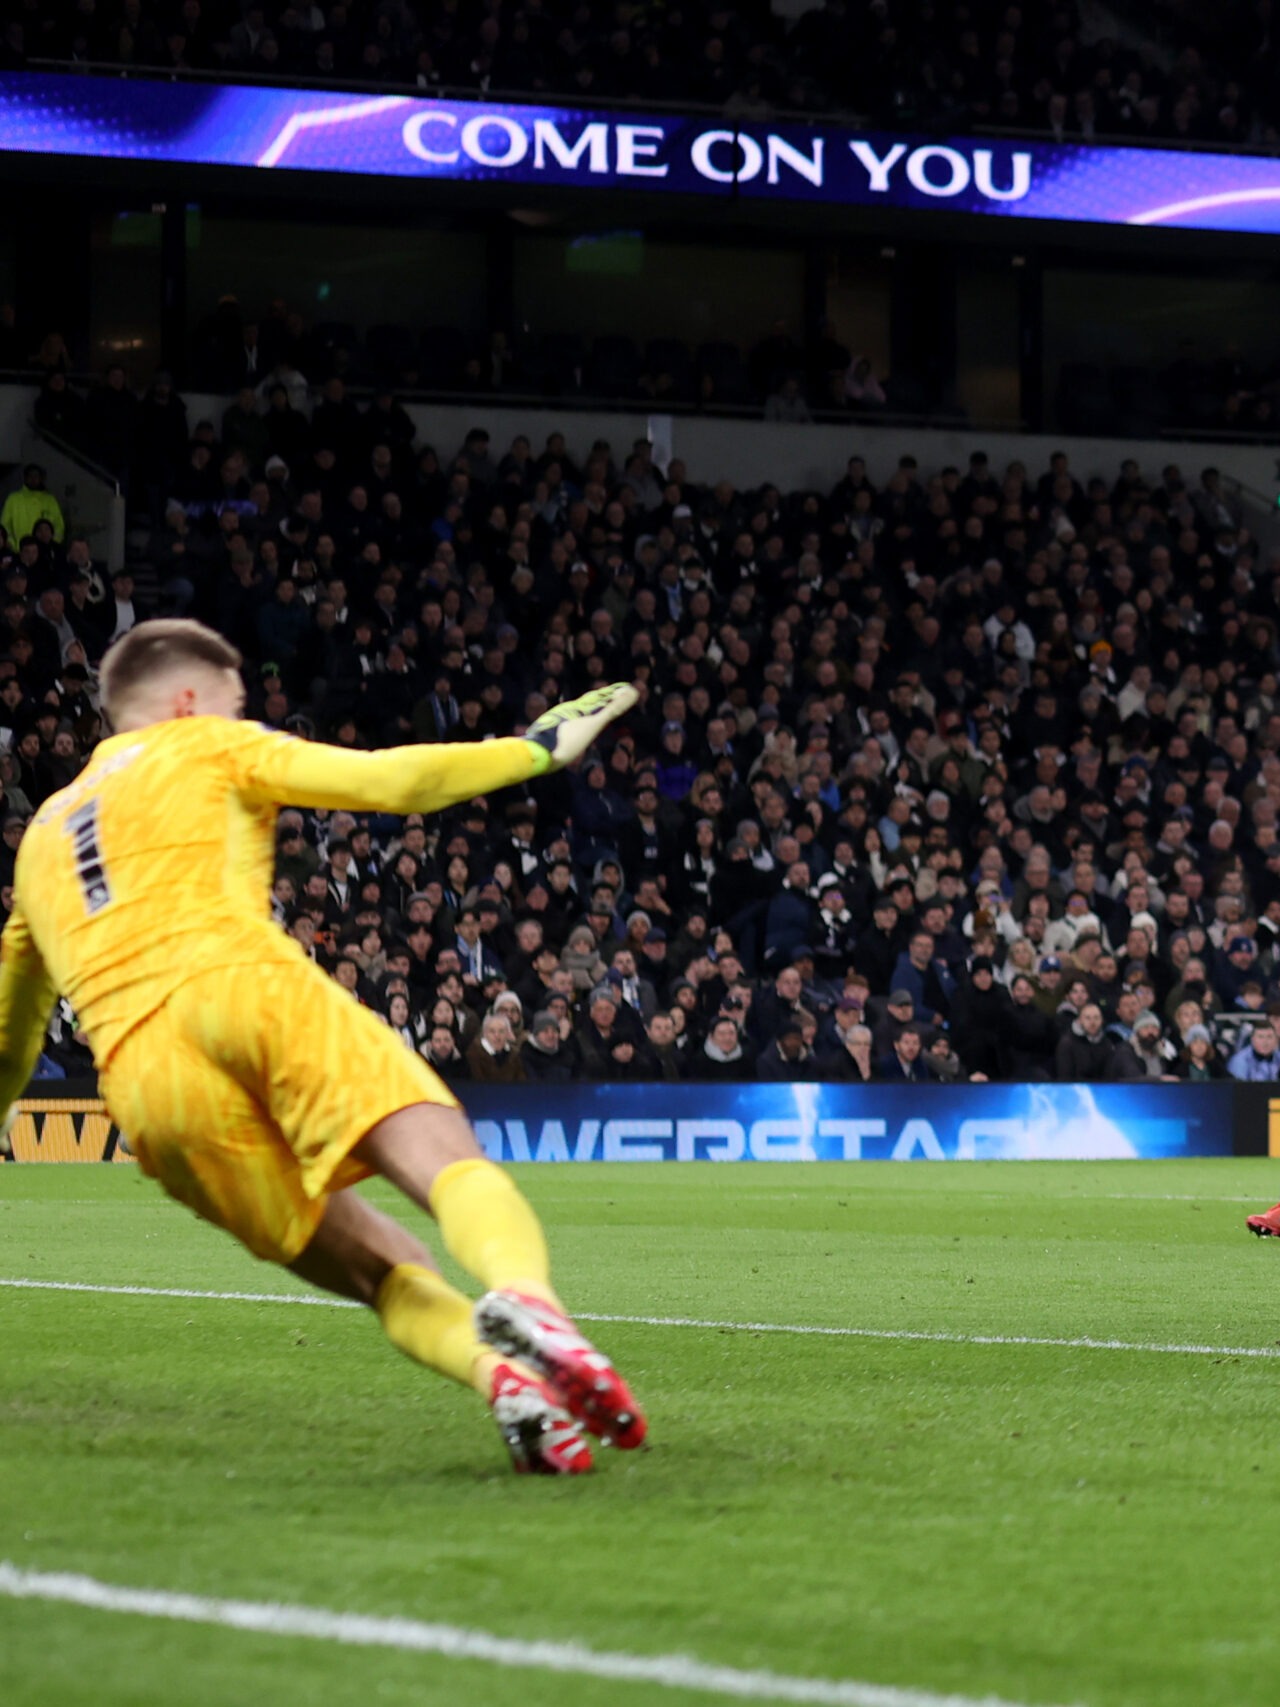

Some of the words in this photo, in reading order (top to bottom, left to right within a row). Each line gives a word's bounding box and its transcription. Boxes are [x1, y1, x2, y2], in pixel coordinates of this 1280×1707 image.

[402, 110, 669, 177] COME
[690, 129, 824, 188] ON
[849, 140, 1032, 202] YOU
[64, 798, 110, 915] 1
